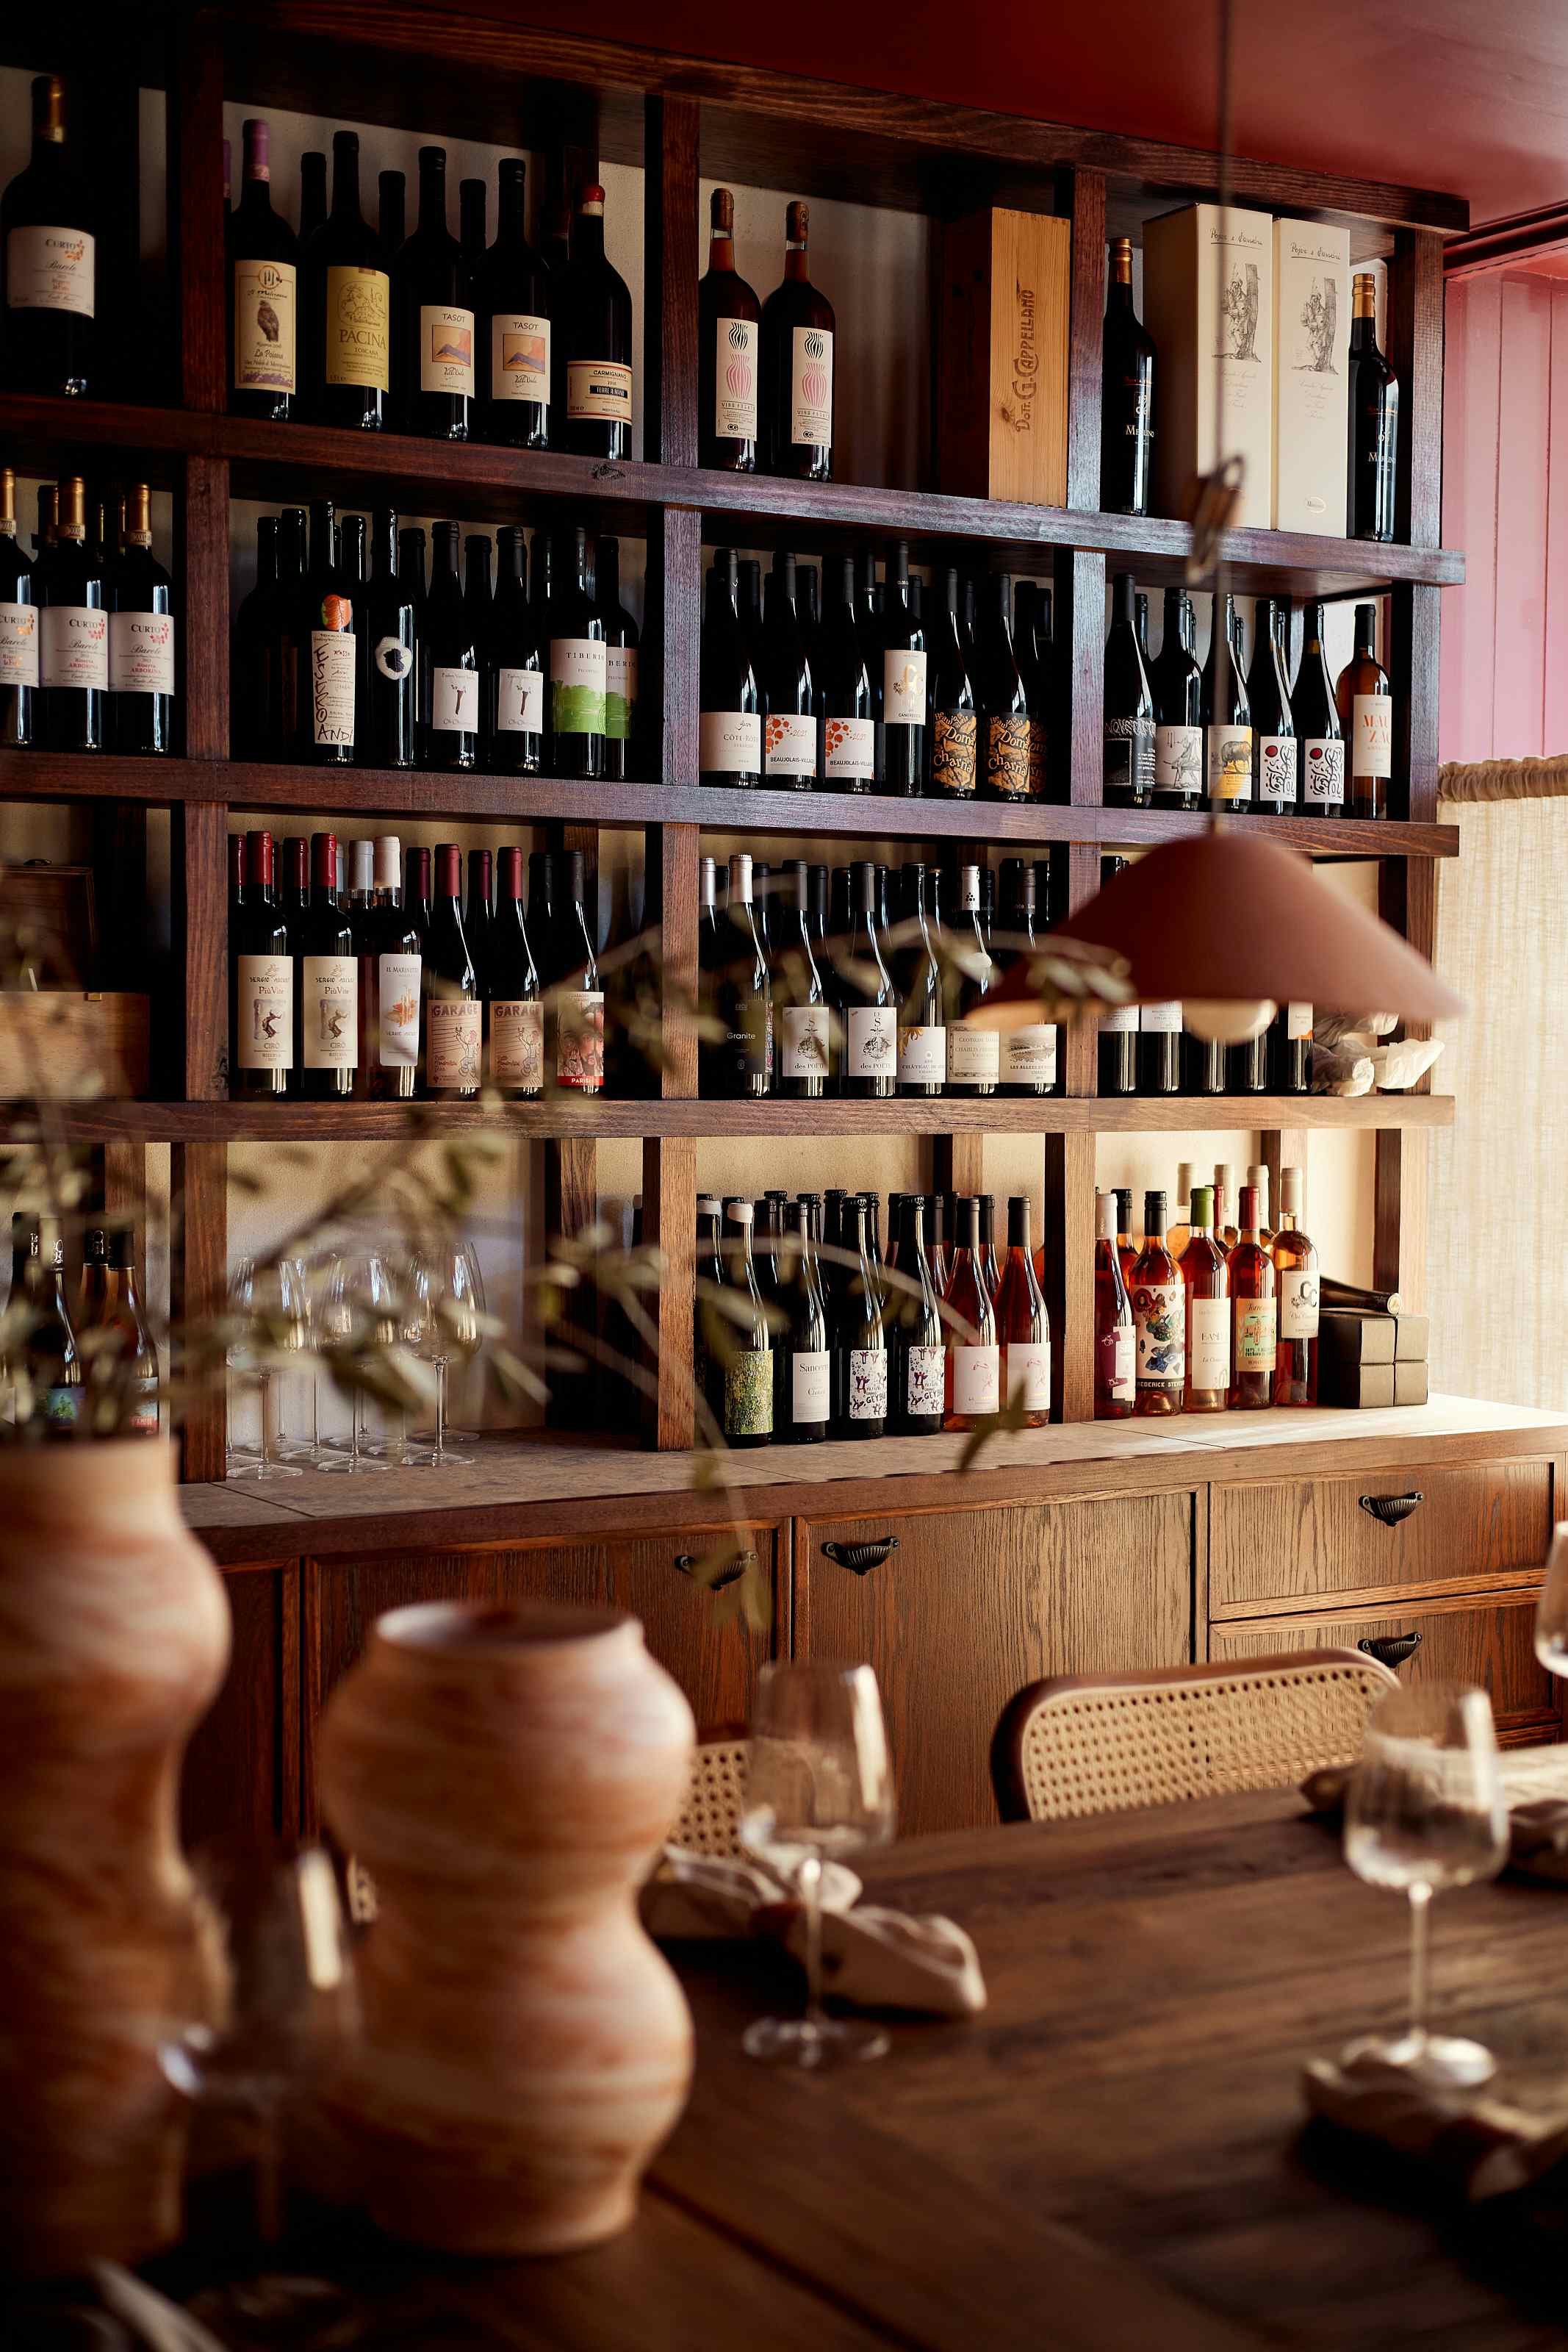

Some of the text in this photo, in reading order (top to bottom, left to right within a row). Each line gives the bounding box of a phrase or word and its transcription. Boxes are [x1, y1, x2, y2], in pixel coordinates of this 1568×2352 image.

[45, 239, 76, 250] CURTO
[441, 313, 466, 323] TASOT
[513, 322, 539, 331] TASOT
[339, 329, 387, 351] PACINA
[593, 370, 627, 380] CARMIGNANO
[69, 619, 99, 629] CURTO
[131, 623, 161, 634] CURTO
[566, 652, 605, 660] TIBERIO
[433, 1004, 478, 1017] GARAGE
[495, 1005, 540, 1017] GARAGE
